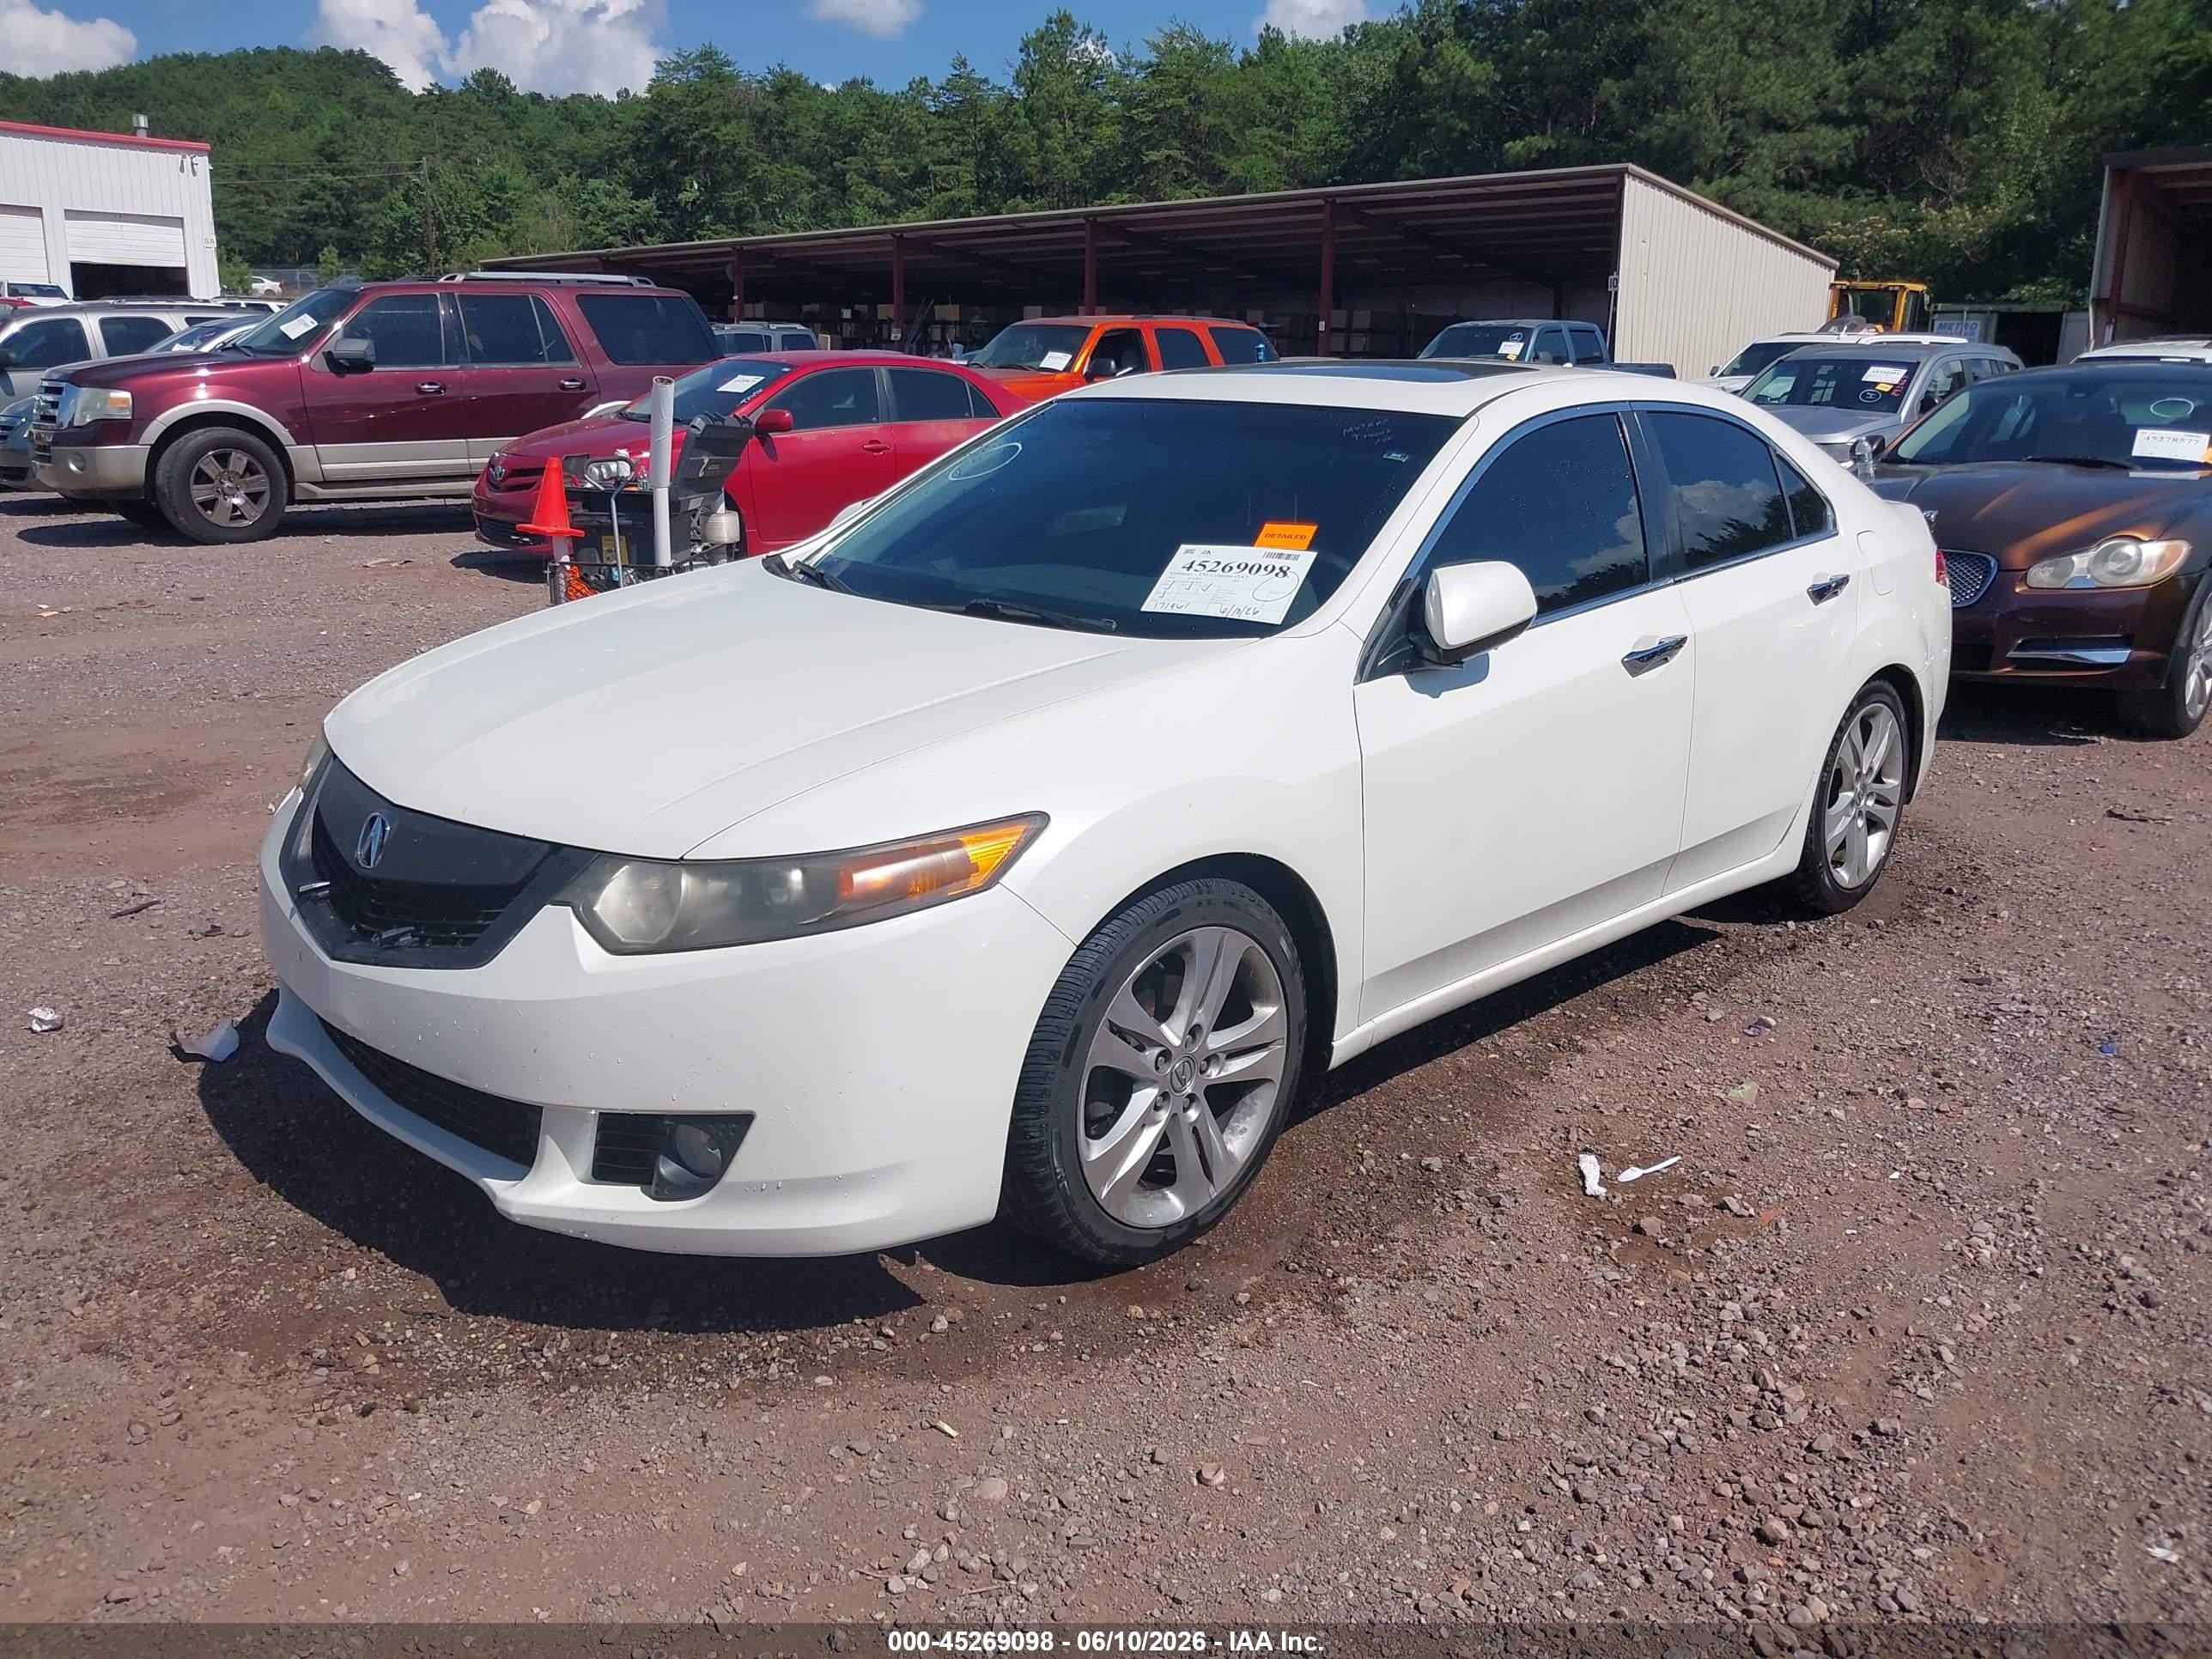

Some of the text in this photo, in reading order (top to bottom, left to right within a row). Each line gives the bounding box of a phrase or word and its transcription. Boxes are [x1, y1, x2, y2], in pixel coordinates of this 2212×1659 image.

[1937, 322, 1979, 331] METRO
[1264, 532, 1307, 541] DETAILED
[1181, 559, 1291, 579] 45269098
